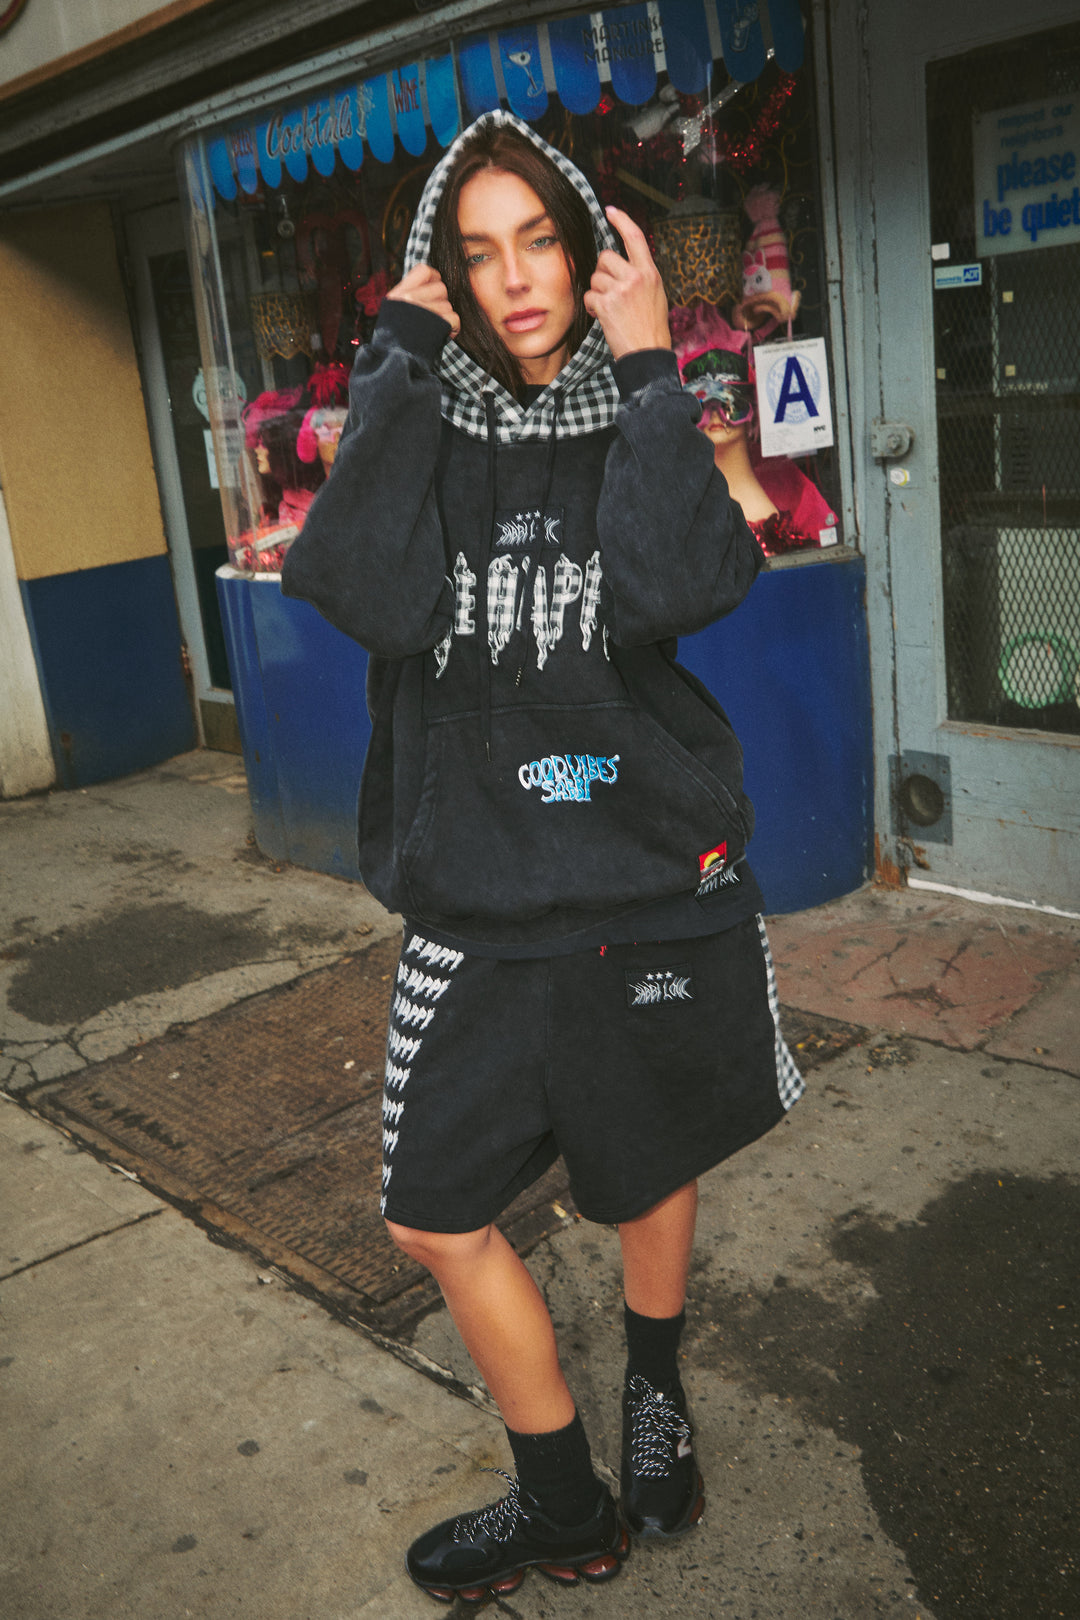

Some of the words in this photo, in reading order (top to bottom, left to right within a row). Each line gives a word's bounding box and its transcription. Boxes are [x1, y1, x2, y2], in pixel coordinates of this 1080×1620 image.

[582, 16, 658, 46] MARTINIS
[583, 36, 669, 65] MANICURES
[392, 77, 420, 114] WINE
[1051, 103, 1074, 118] our
[265, 95, 354, 159] Cocktails
[996, 151, 1077, 203] please
[983, 199, 1012, 238] be
[1021, 187, 1080, 242] quiet
[774, 356, 819, 424] A
[541, 775, 592, 804] SABBI
